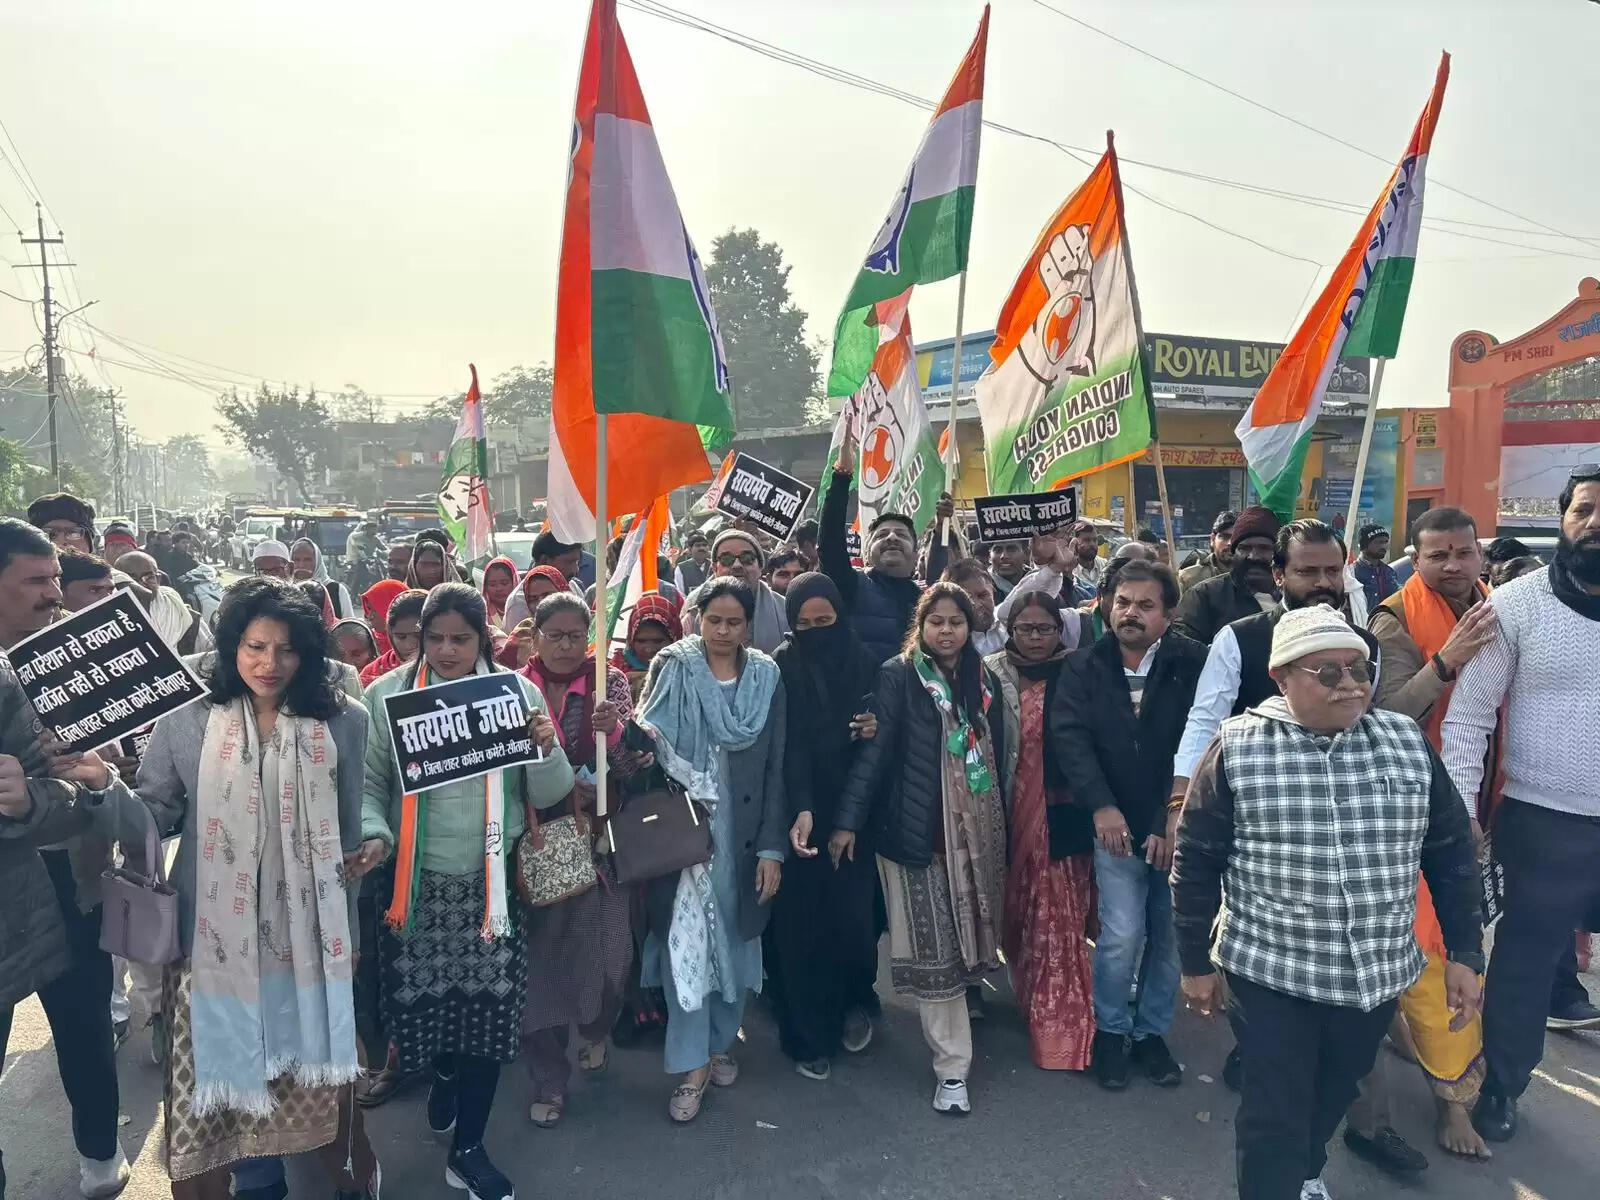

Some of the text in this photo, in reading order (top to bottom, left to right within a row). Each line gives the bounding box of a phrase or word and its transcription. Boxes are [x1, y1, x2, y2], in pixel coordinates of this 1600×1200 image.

[1155, 339, 1235, 378] ROYAL
[1504, 345, 1554, 362] PM SHRI
[730, 468, 802, 519] सत्यमेव जयते
[981, 501, 1031, 524] सत्यमेव
[1035, 494, 1071, 520] जयते
[17, 663, 36, 686] सत्य
[31, 645, 71, 675] परेशान
[65, 634, 86, 659] हो
[80, 620, 124, 650] सकता
[33, 686, 71, 714] पराजित
[88, 662, 110, 686] हो
[103, 647, 148, 677] सकता
[98, 697, 135, 723] कांग्रेस
[397, 685, 526, 753] सत्यमेव जयते
[460, 747, 485, 767] कांग्रेस
